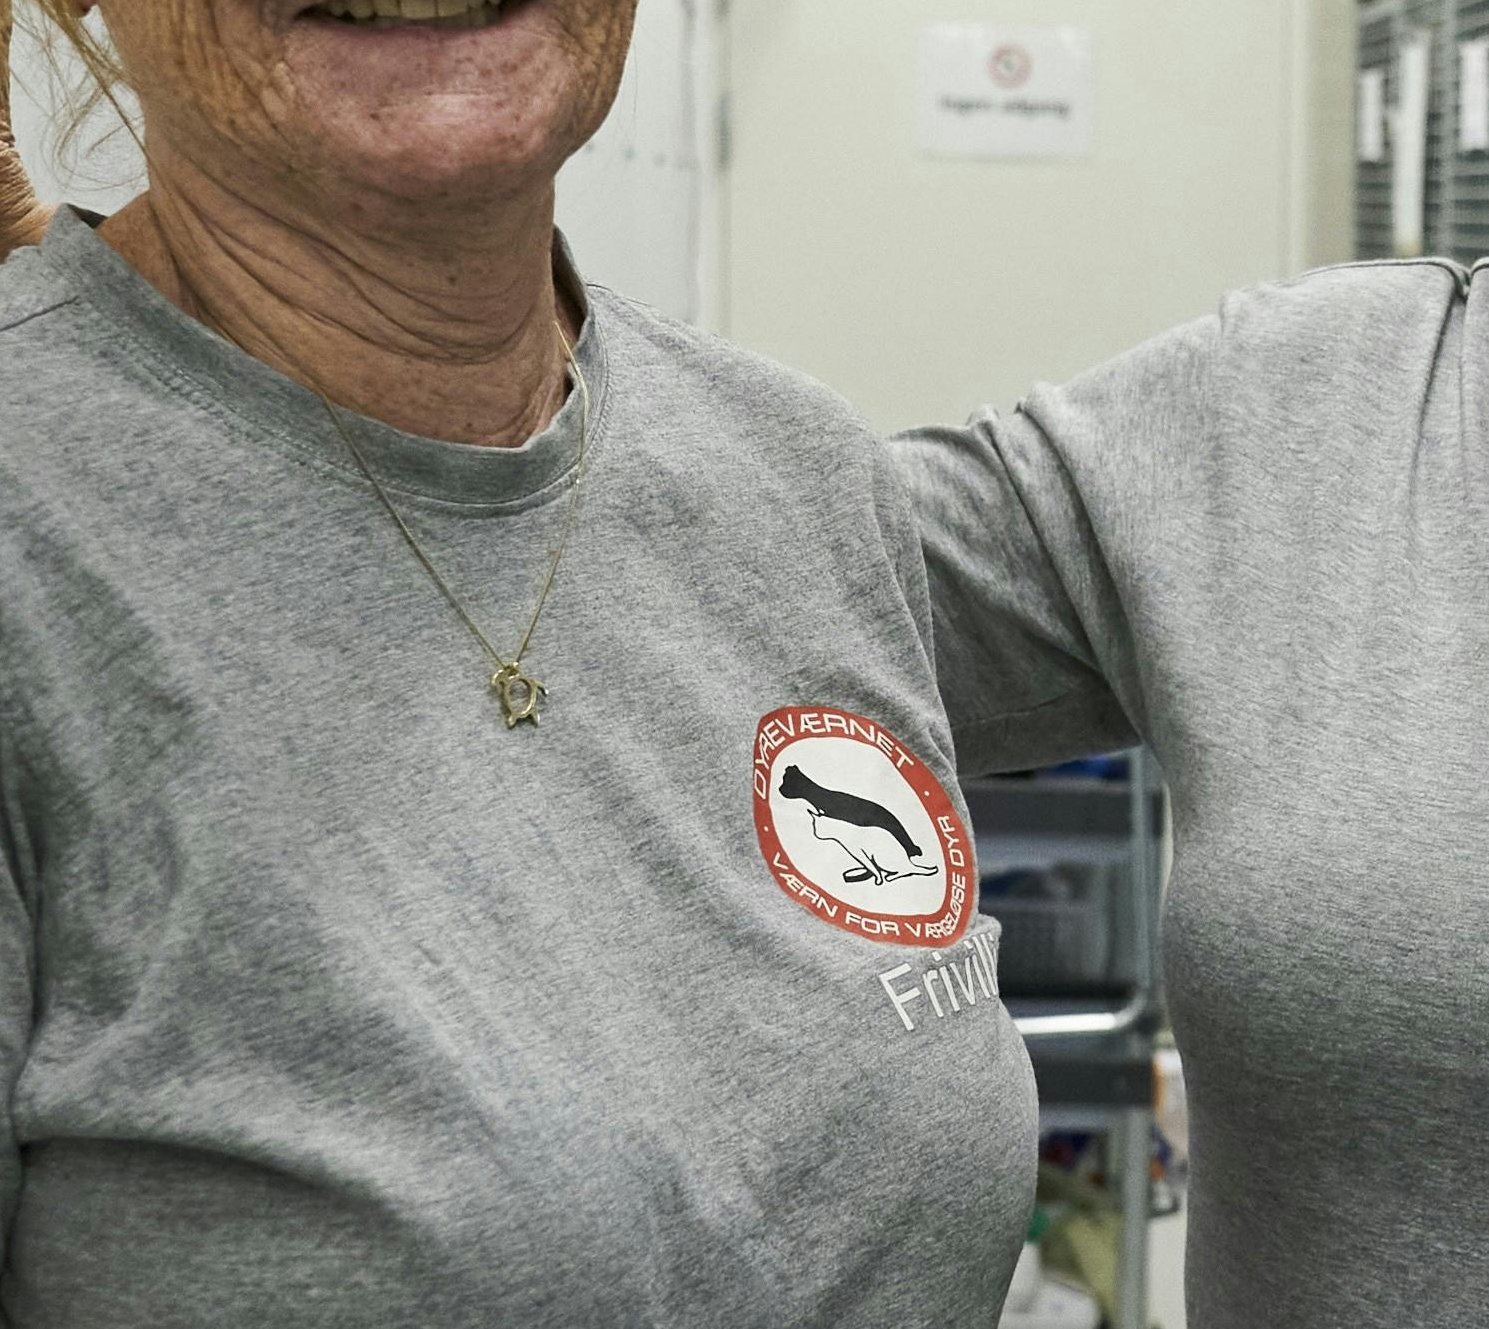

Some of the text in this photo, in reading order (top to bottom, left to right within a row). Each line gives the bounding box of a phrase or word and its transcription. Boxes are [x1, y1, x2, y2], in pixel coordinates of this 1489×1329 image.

[754, 712, 915, 800] DYREVÆRNET
[773, 852, 839, 918] VÆRN
[845, 912, 900, 936] FOR
[937, 814, 965, 868] DYR
